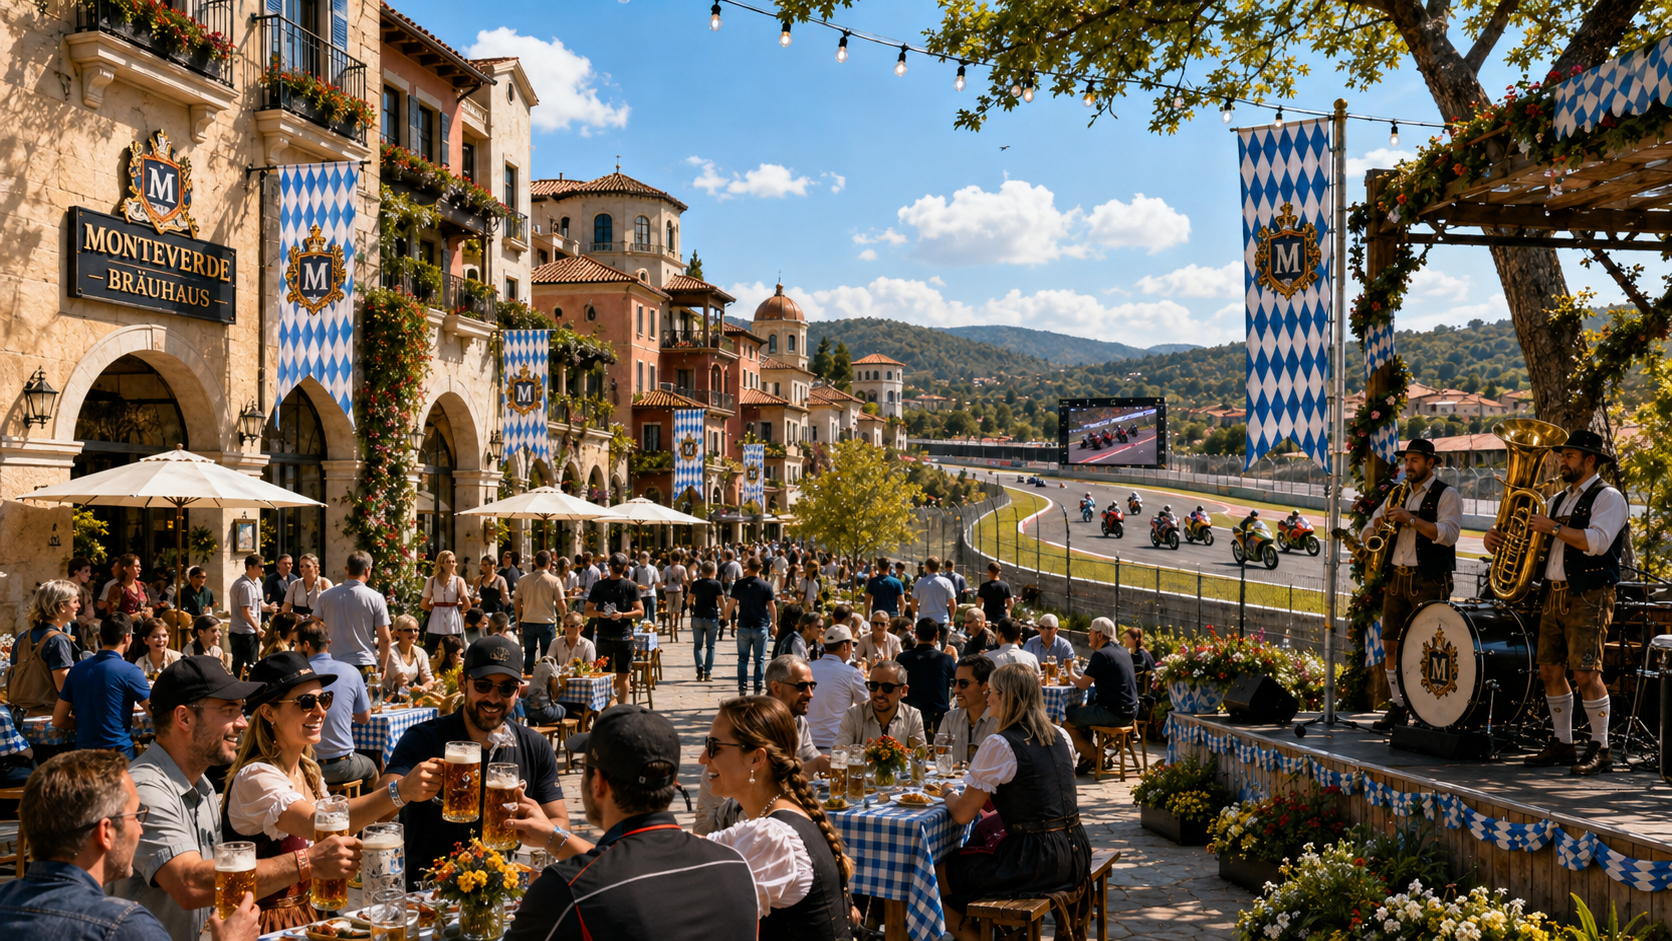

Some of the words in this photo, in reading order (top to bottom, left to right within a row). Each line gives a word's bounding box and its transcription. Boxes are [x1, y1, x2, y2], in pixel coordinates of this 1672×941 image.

[147, 166, 176, 204] M
[83, 223, 231, 283] MONTEVERDE
[1274, 242, 1301, 274] M
[107, 268, 210, 308] BRÄUHAUS
[303, 263, 328, 290] M
[516, 385, 533, 403] M
[1431, 657, 1448, 682] M
